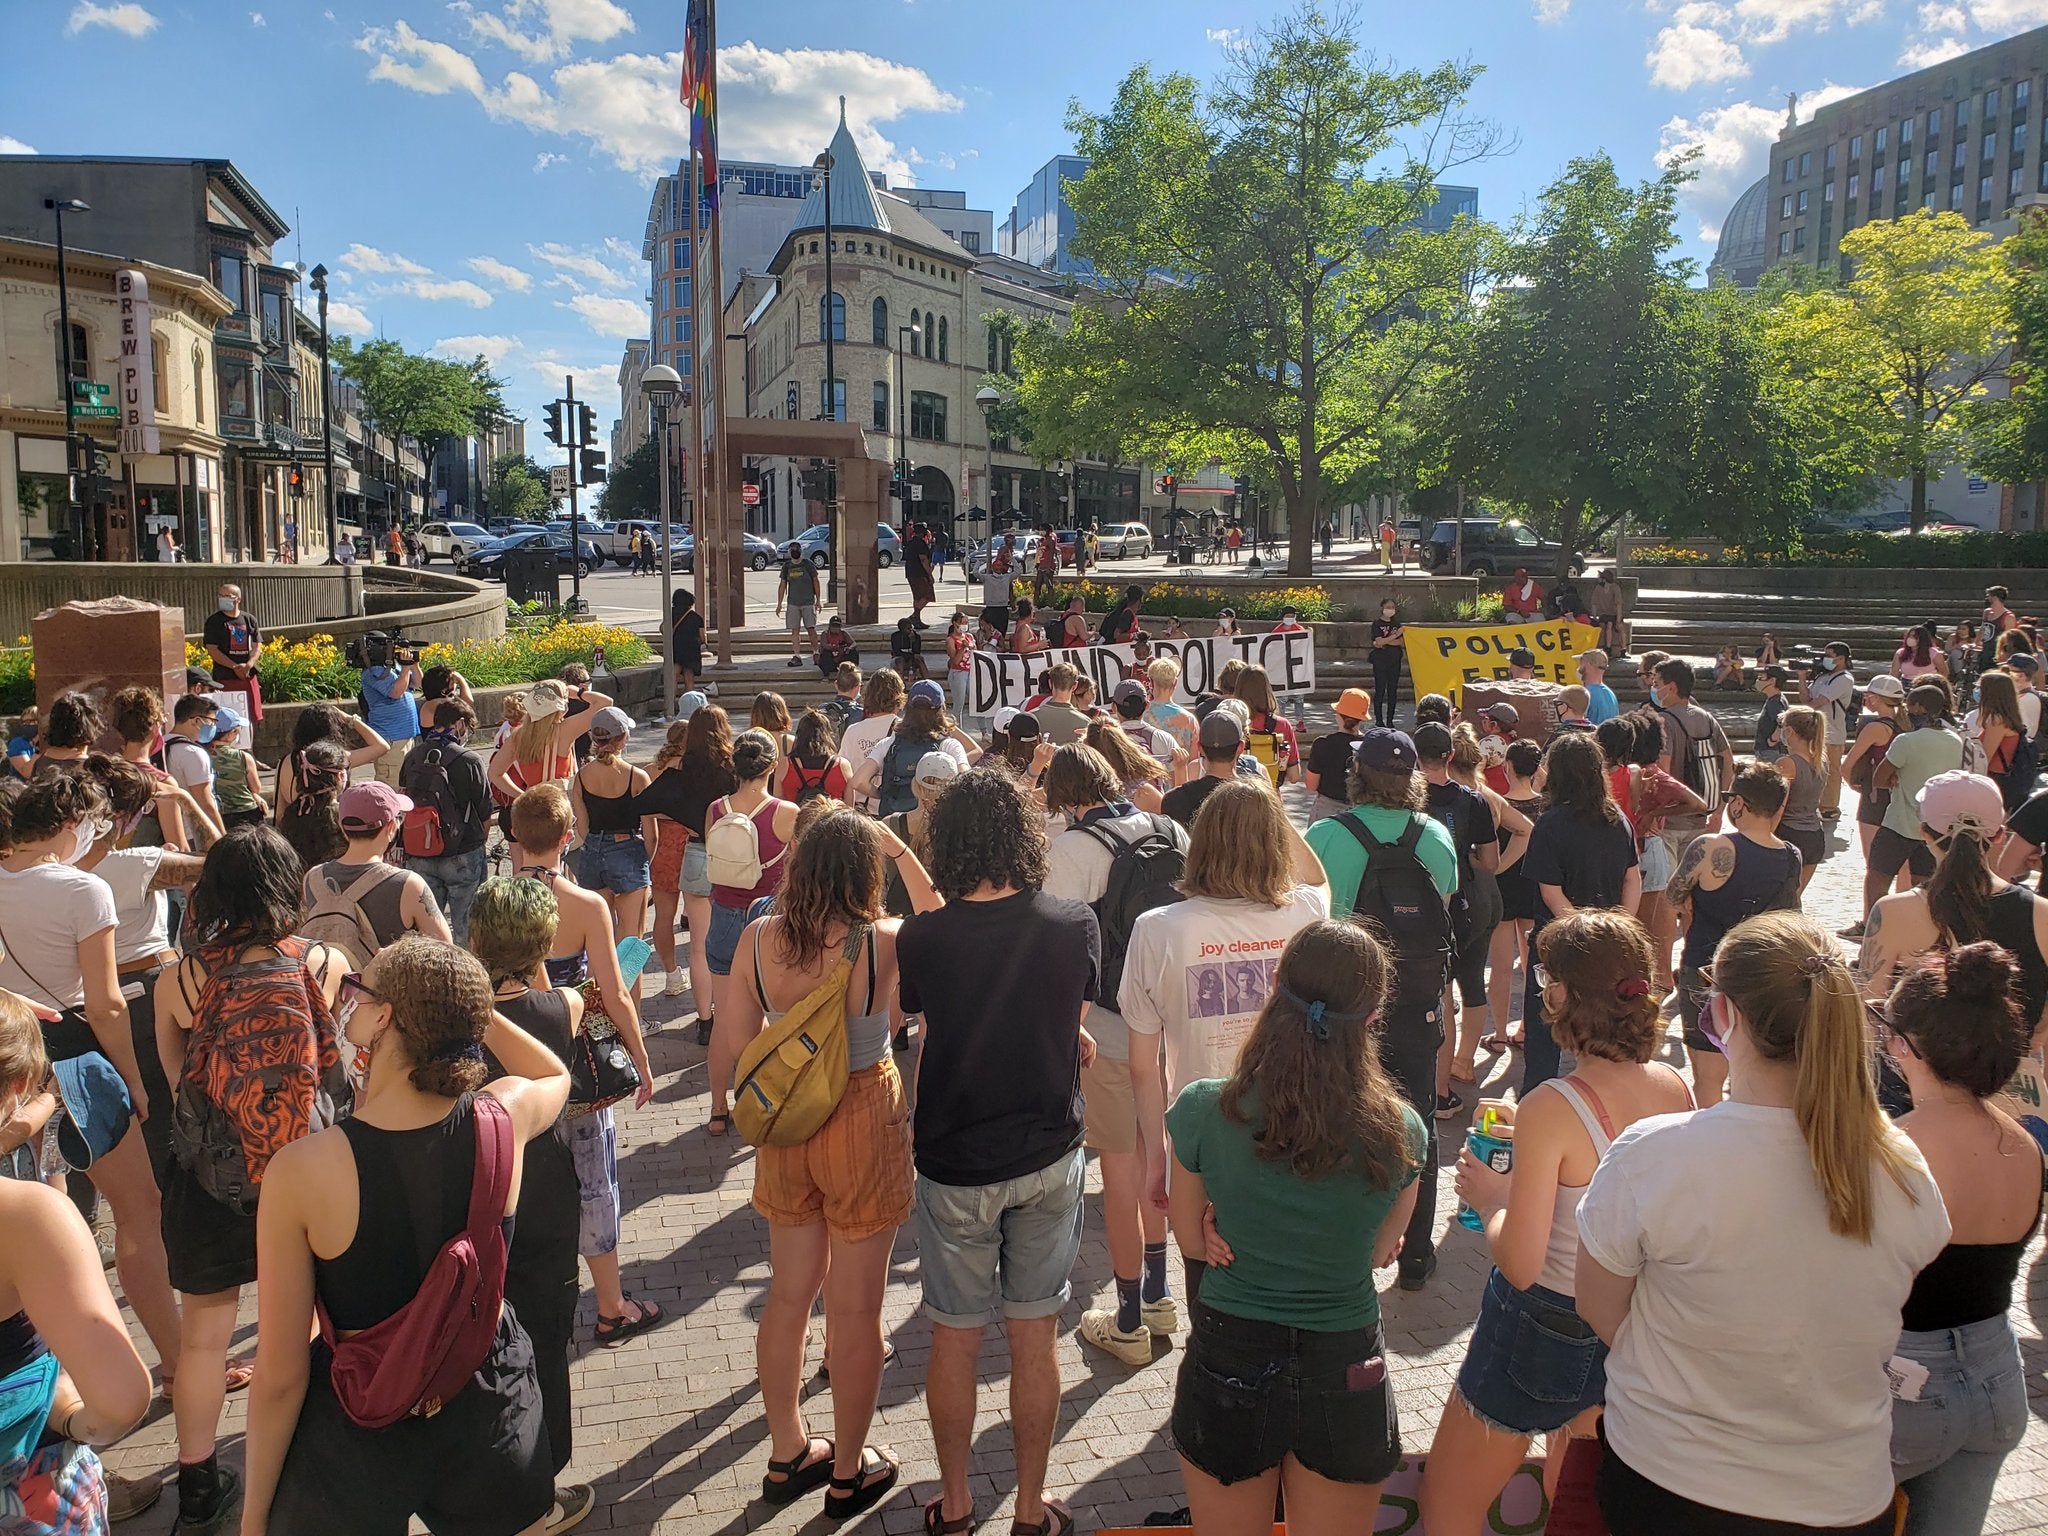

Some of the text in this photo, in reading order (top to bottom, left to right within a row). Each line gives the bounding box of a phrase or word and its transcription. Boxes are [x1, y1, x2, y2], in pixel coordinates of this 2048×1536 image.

[120, 276, 139, 425] BREW PUB
[81, 383, 98, 394] King
[81, 406, 108, 415] Webster
[117, 429, 145, 453] POOL
[553, 469, 568, 477] ONE
[553, 478, 568, 486] WAY
[1436, 628, 1573, 658] POLICE
[1199, 938, 1286, 957] joy cleaner
